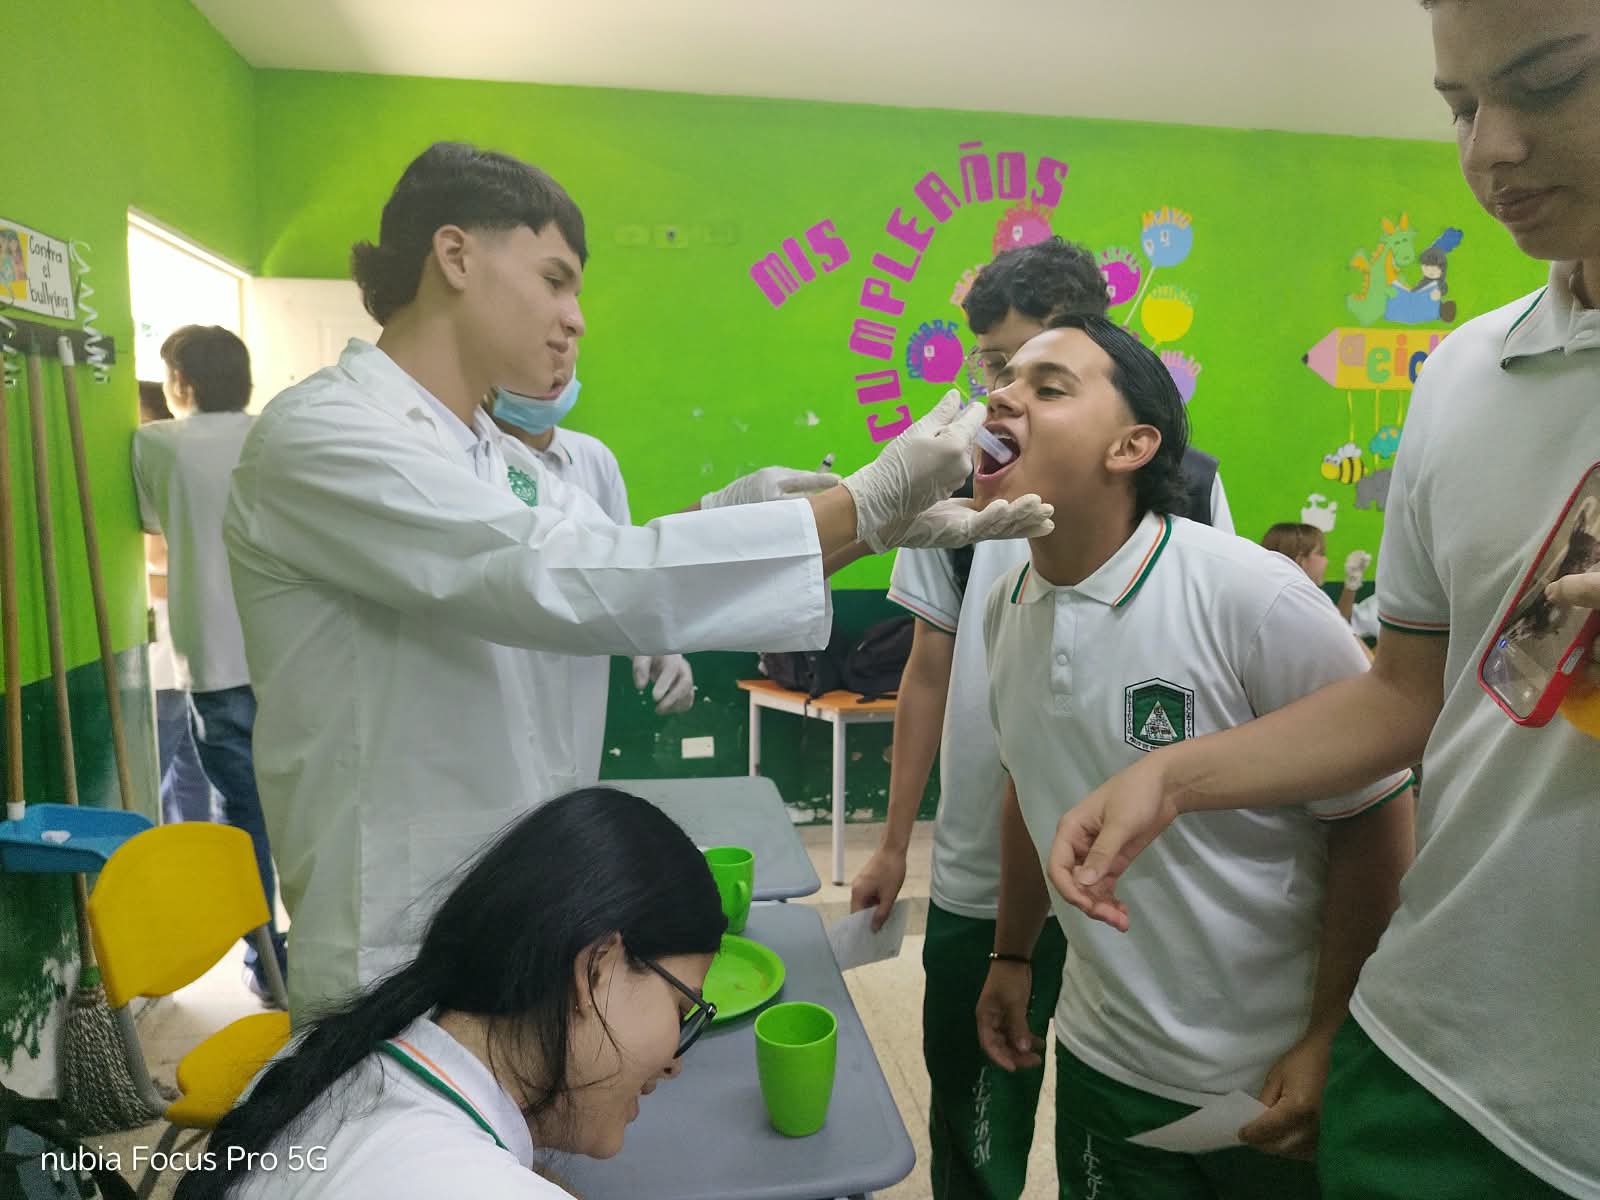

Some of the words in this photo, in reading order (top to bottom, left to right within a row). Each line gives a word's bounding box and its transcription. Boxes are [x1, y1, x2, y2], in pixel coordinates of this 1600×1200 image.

[1142, 205, 1193, 232] MAYO
[29, 235, 62, 263] Contra
[42, 262, 51, 278] el
[29, 280, 69, 317] bullying
[749, 218, 851, 308] MIS
[848, 140, 1069, 444] CUMPLEAÑOS
[1339, 333, 1449, 384] aeio
